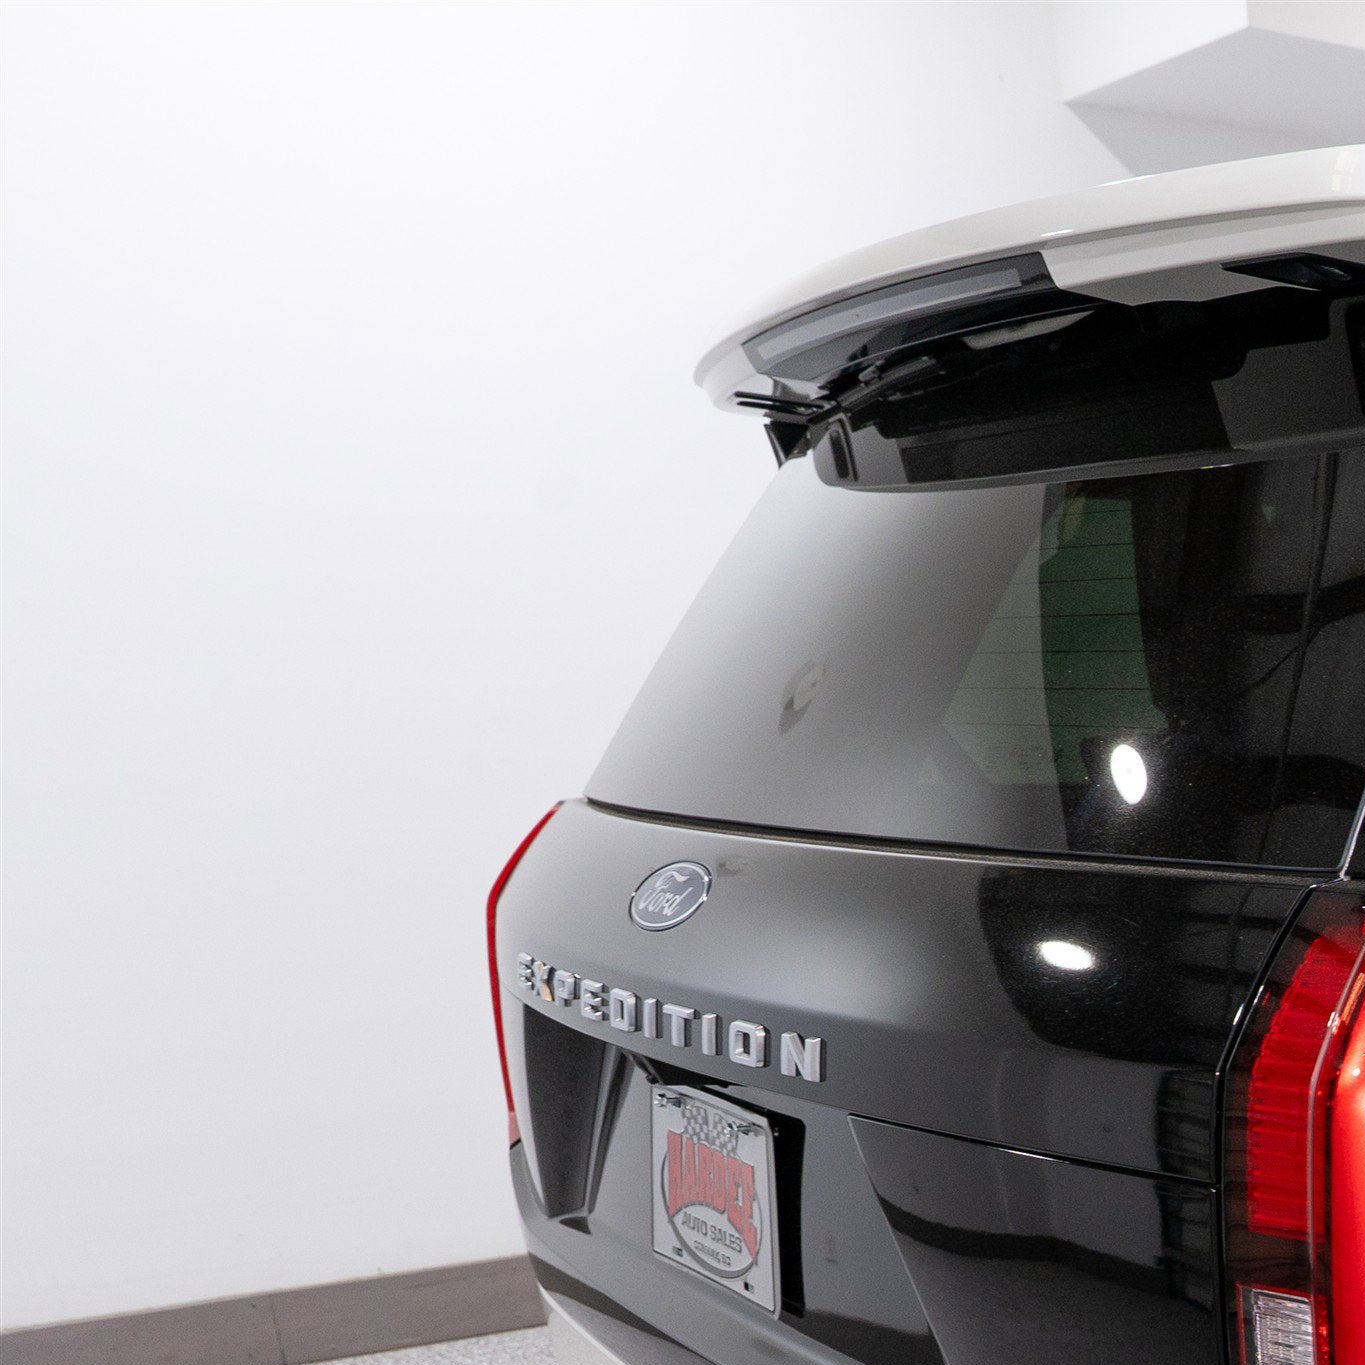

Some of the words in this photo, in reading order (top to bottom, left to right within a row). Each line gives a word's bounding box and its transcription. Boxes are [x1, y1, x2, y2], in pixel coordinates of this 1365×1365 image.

[638, 870, 695, 917] Ford
[517, 951, 824, 1083] EXPEDITION
[667, 1129, 757, 1260] HARDEE
[682, 1211, 708, 1237] AUTO
[710, 1225, 743, 1253] SALES
